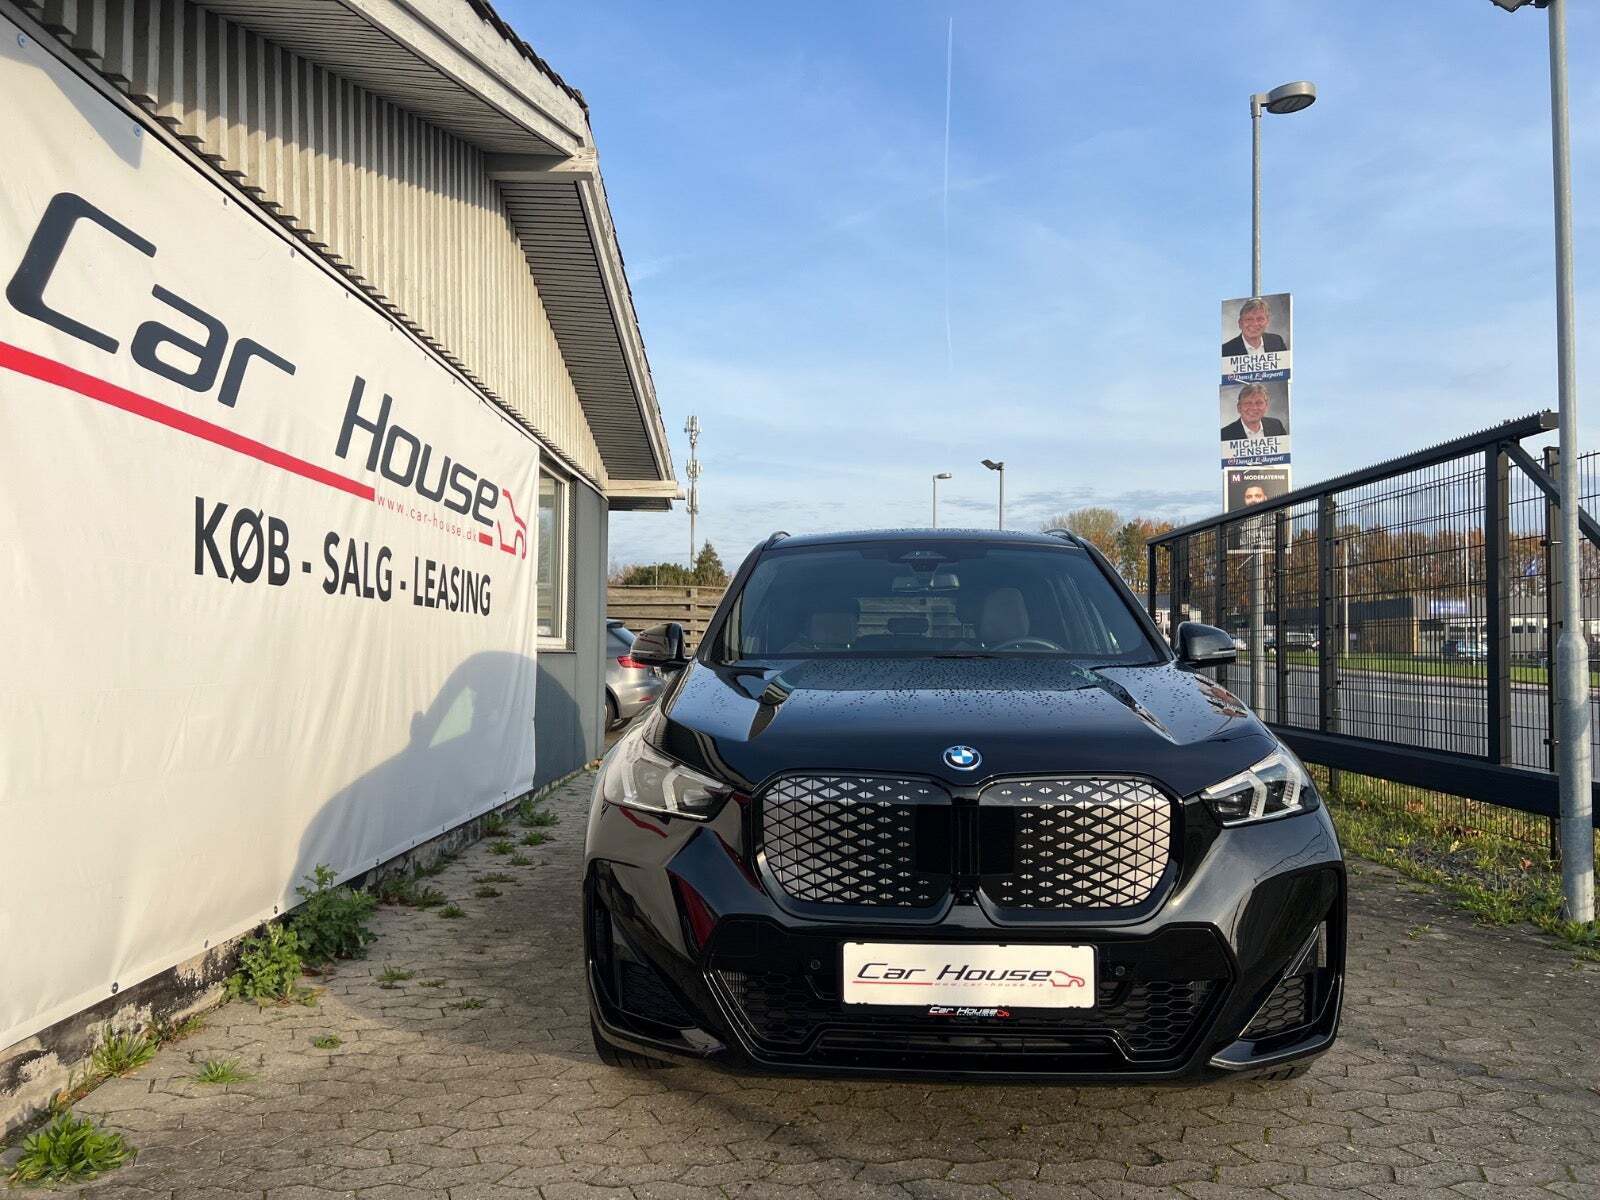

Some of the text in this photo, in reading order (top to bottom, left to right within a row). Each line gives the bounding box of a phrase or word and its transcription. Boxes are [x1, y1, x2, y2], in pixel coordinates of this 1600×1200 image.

[6, 192, 499, 528] Car House
[1230, 353, 1282, 366] MICHAEL
[1233, 362, 1278, 373] JENSEN
[1230, 437, 1281, 449] MICHAEL
[1233, 446, 1278, 457] JENSEN
[1232, 474, 1241, 482] M
[377, 495, 477, 542] www.car-house.dk
[194, 496, 291, 587] KØB
[322, 531, 393, 602] SALG
[413, 556, 491, 616] LEASING
[857, 962, 1052, 981] Car House
[928, 1006, 954, 1014] Car
[956, 1007, 998, 1016] House
